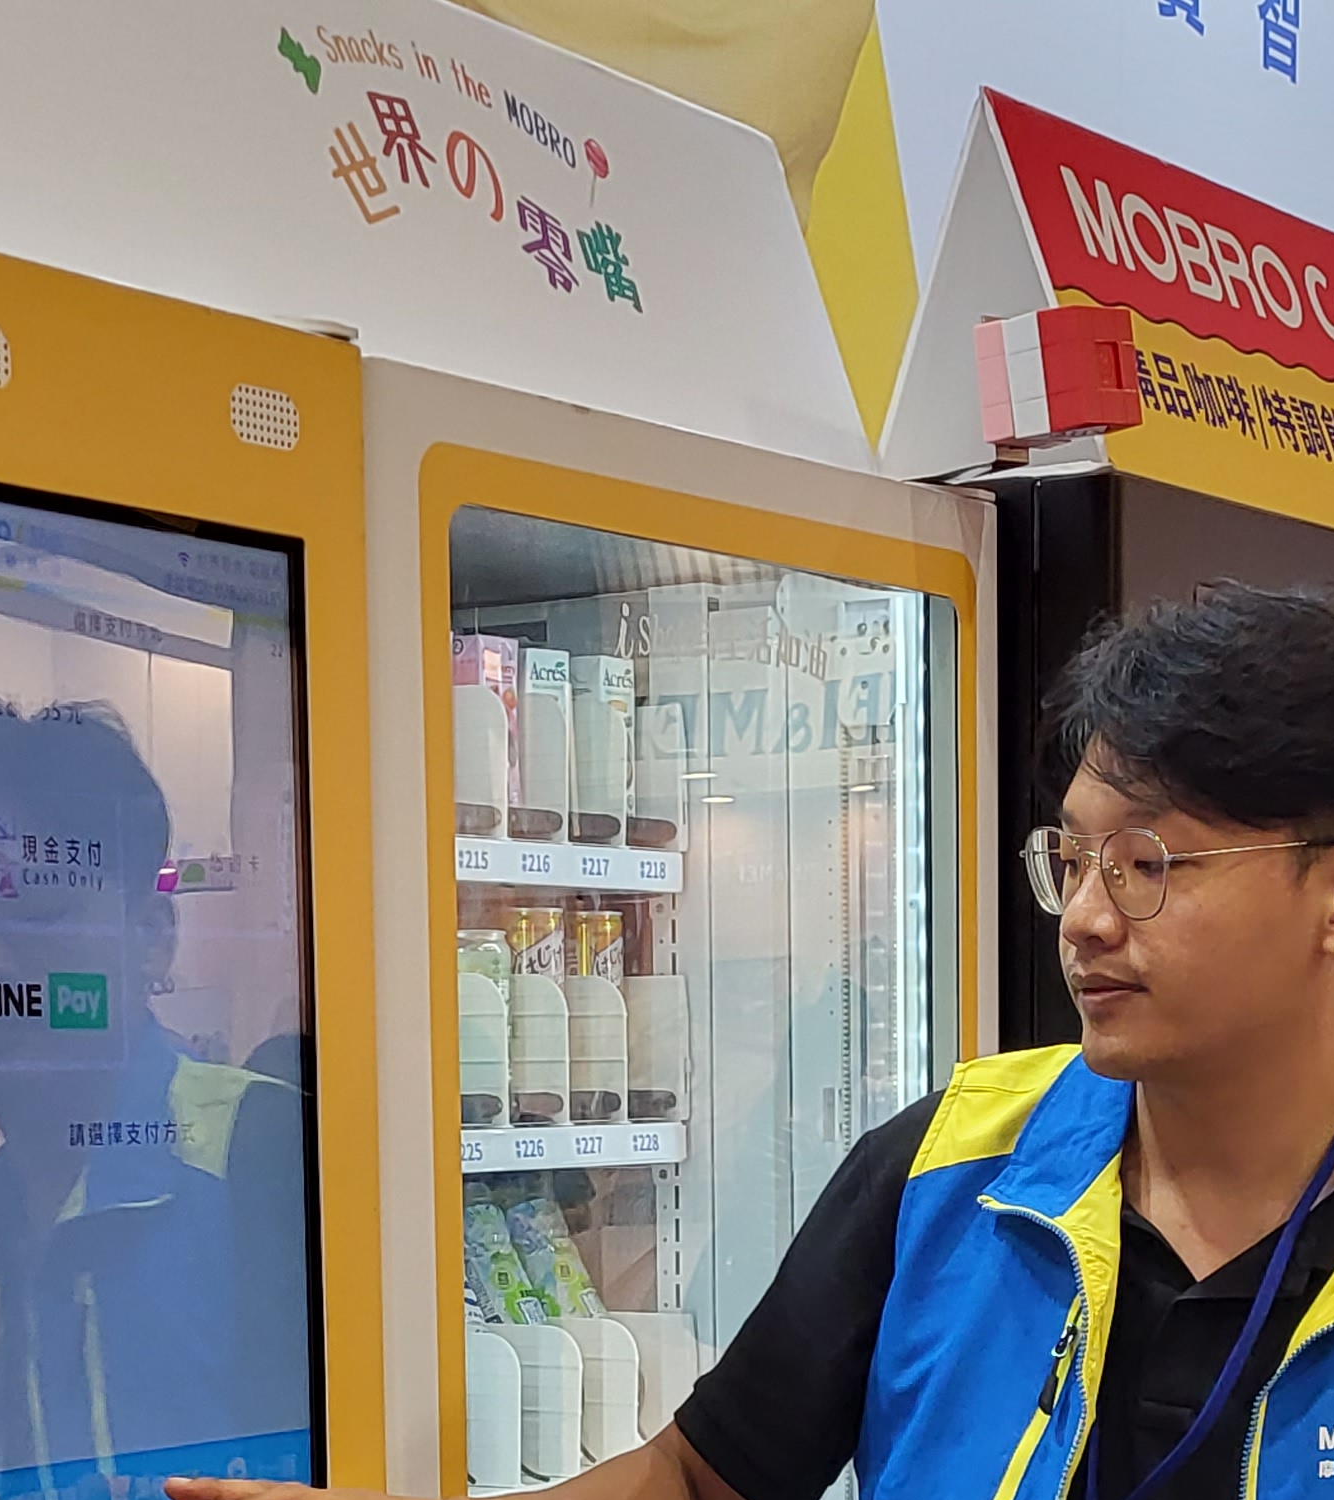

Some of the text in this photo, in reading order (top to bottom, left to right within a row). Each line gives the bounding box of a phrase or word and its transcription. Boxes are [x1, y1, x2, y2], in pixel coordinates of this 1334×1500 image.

[316, 25, 577, 168] Snacks in the MOBRO
[328, 91, 643, 314] 世界の零嘴
[1059, 165, 1302, 329] MOBRO
[22, 835, 102, 868] 現金支付
[466, 851, 489, 870] 215
[528, 854, 550, 873] 216
[588, 858, 610, 876] 217
[646, 861, 667, 880] 218
[23, 867, 104, 892] Cash Only
[57, 985, 101, 1020] Pay
[521, 1139, 544, 1158] 226
[581, 1136, 603, 1155] 227
[638, 1134, 660, 1152] 228
